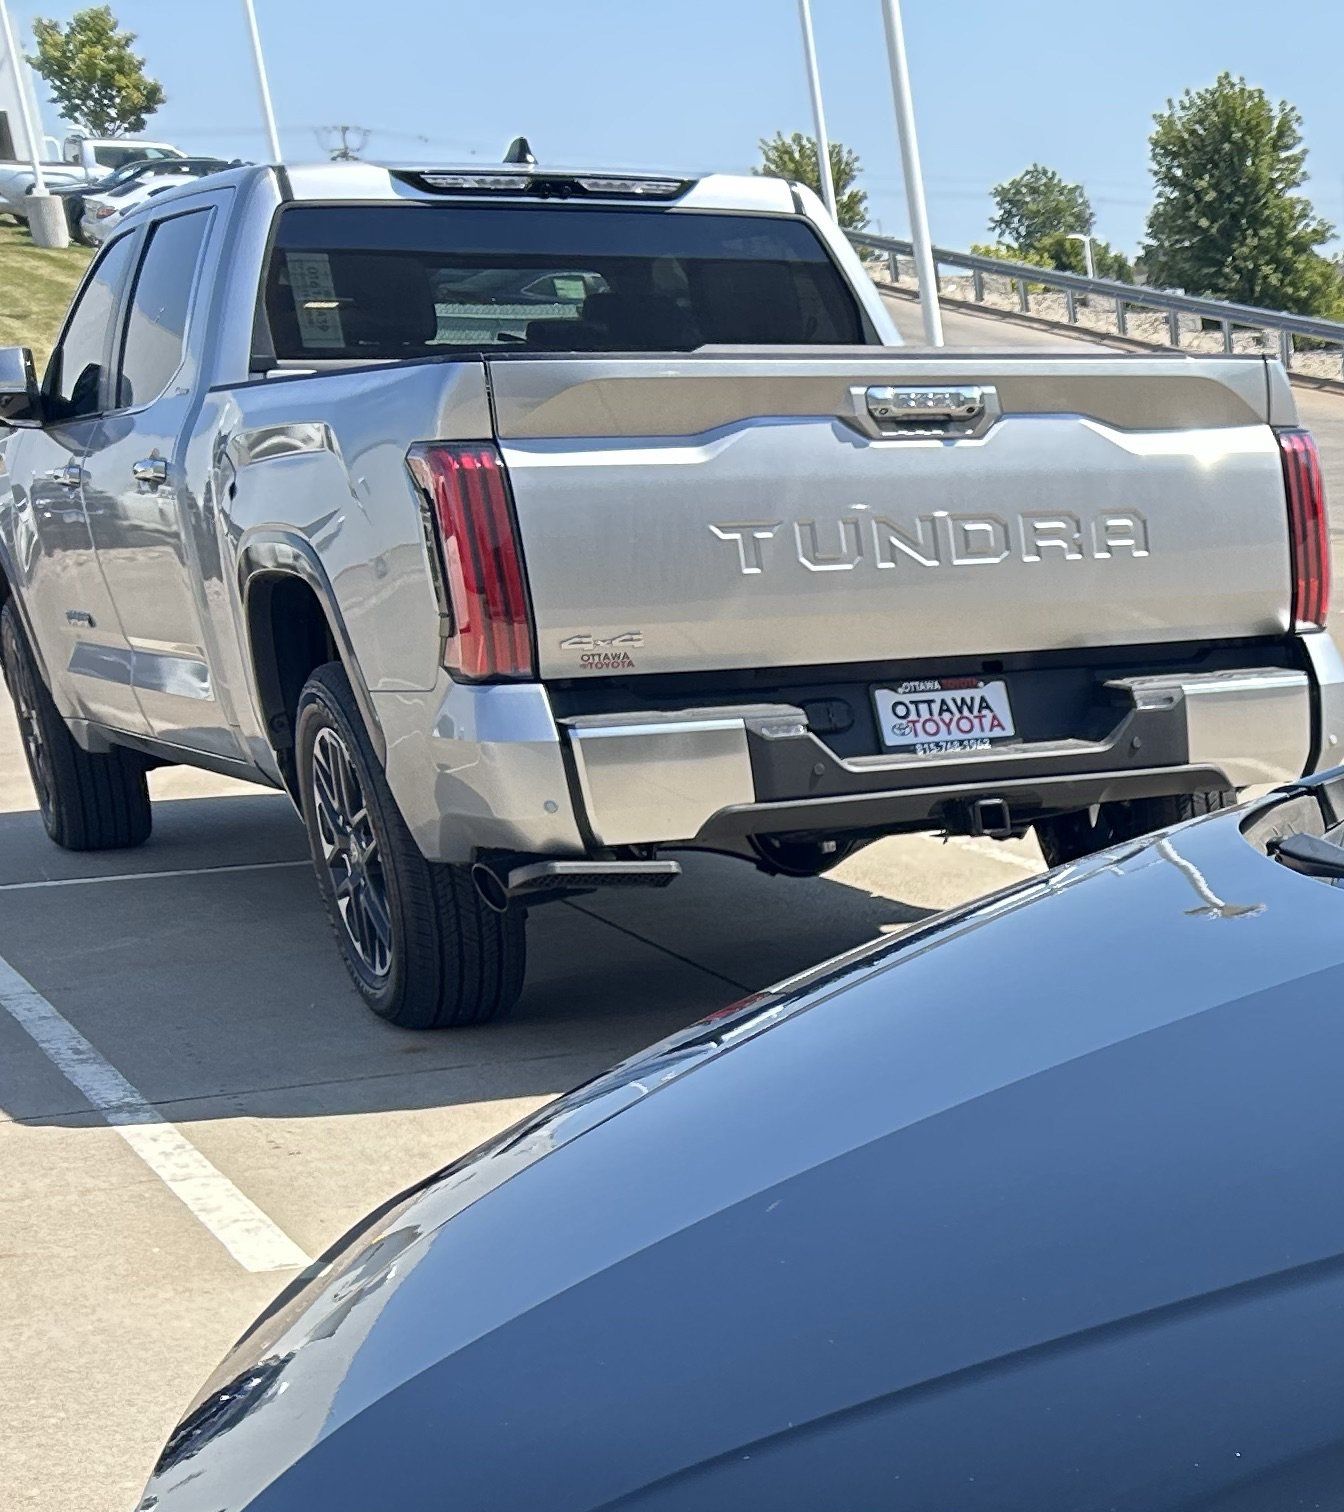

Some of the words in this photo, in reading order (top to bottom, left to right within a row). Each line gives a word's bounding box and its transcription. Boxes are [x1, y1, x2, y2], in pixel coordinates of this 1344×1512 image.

[708, 506, 1150, 575] TUNDRA
[580, 651, 631, 663] OTTAWA
[588, 660, 635, 670] TOYOTA
[901, 680, 941, 694] OTTAWA
[942, 678, 977, 691] TOYOTA
[891, 695, 994, 720] OTTAWA
[907, 713, 1006, 738] TOYOTA
